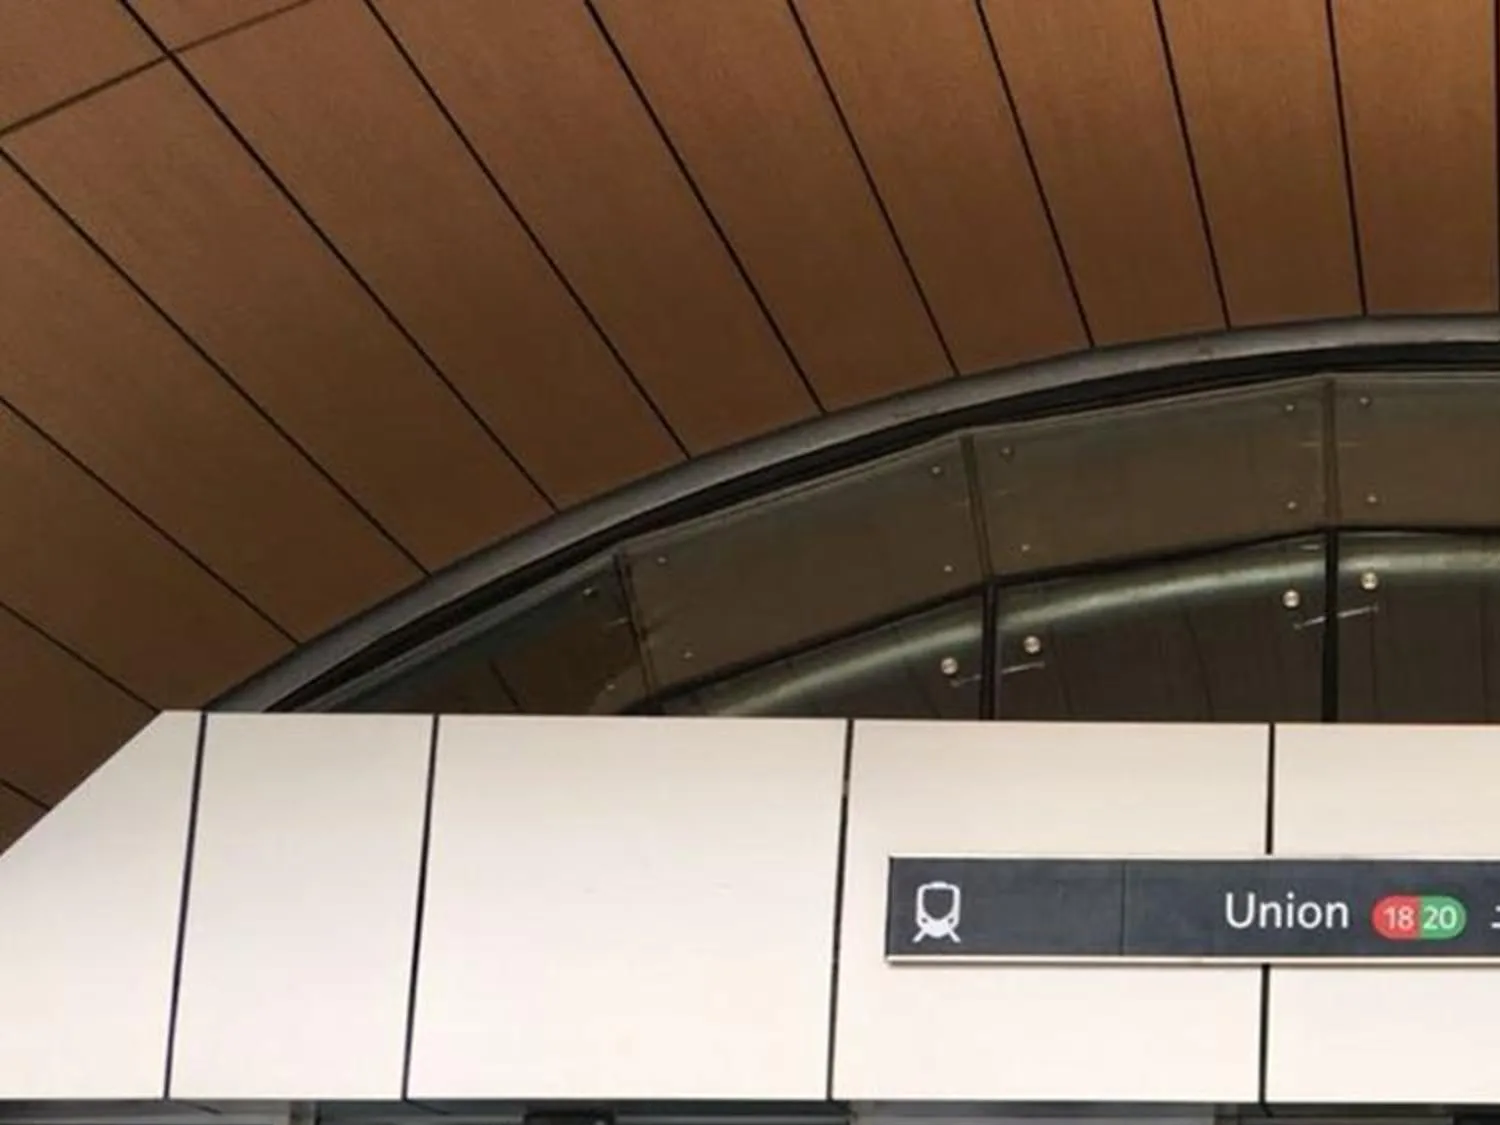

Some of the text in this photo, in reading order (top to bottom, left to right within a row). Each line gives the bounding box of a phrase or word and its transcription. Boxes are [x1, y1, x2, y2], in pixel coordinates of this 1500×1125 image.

[1225, 891, 1349, 929] Union
[1383, 905, 1458, 930] 18 20
